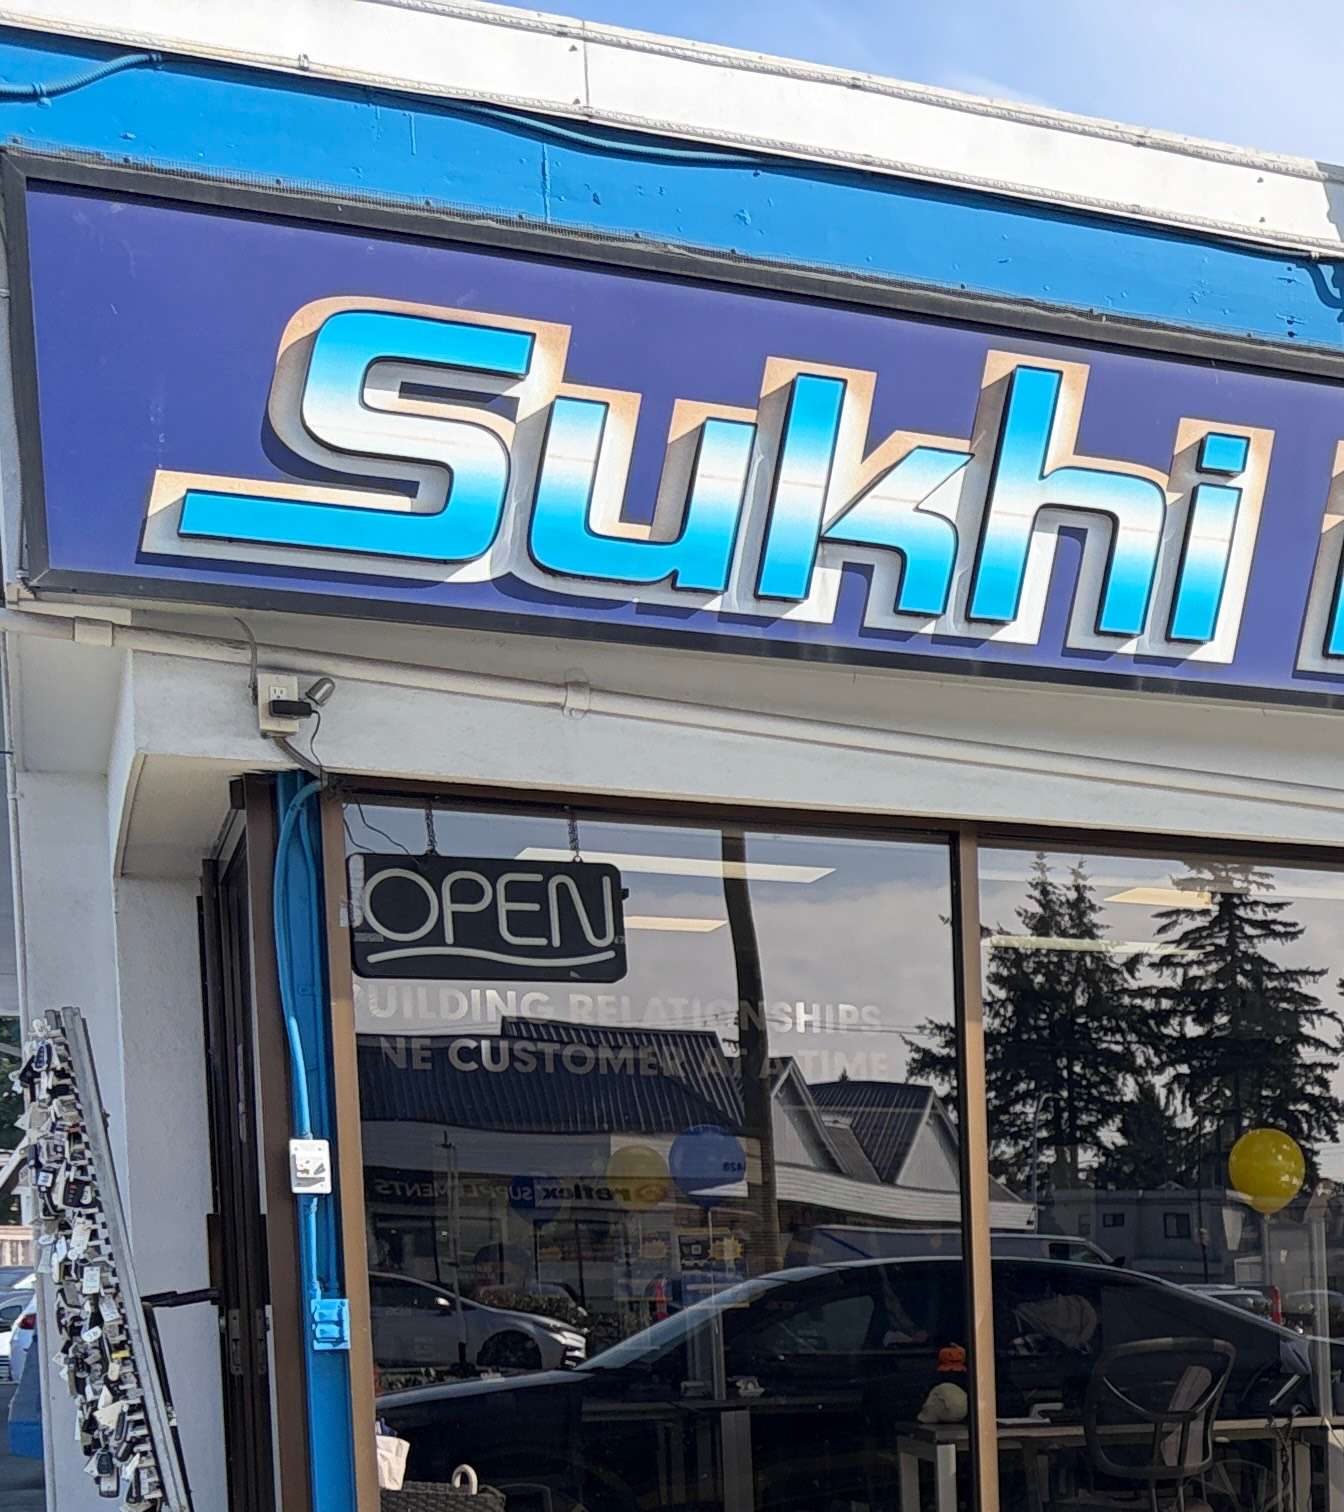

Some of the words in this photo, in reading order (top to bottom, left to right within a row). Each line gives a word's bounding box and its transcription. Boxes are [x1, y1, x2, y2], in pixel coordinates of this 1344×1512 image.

[144, 298, 1272, 662] Sukhi
[363, 868, 616, 948] OPEN
[380, 1036, 433, 1071] NE
